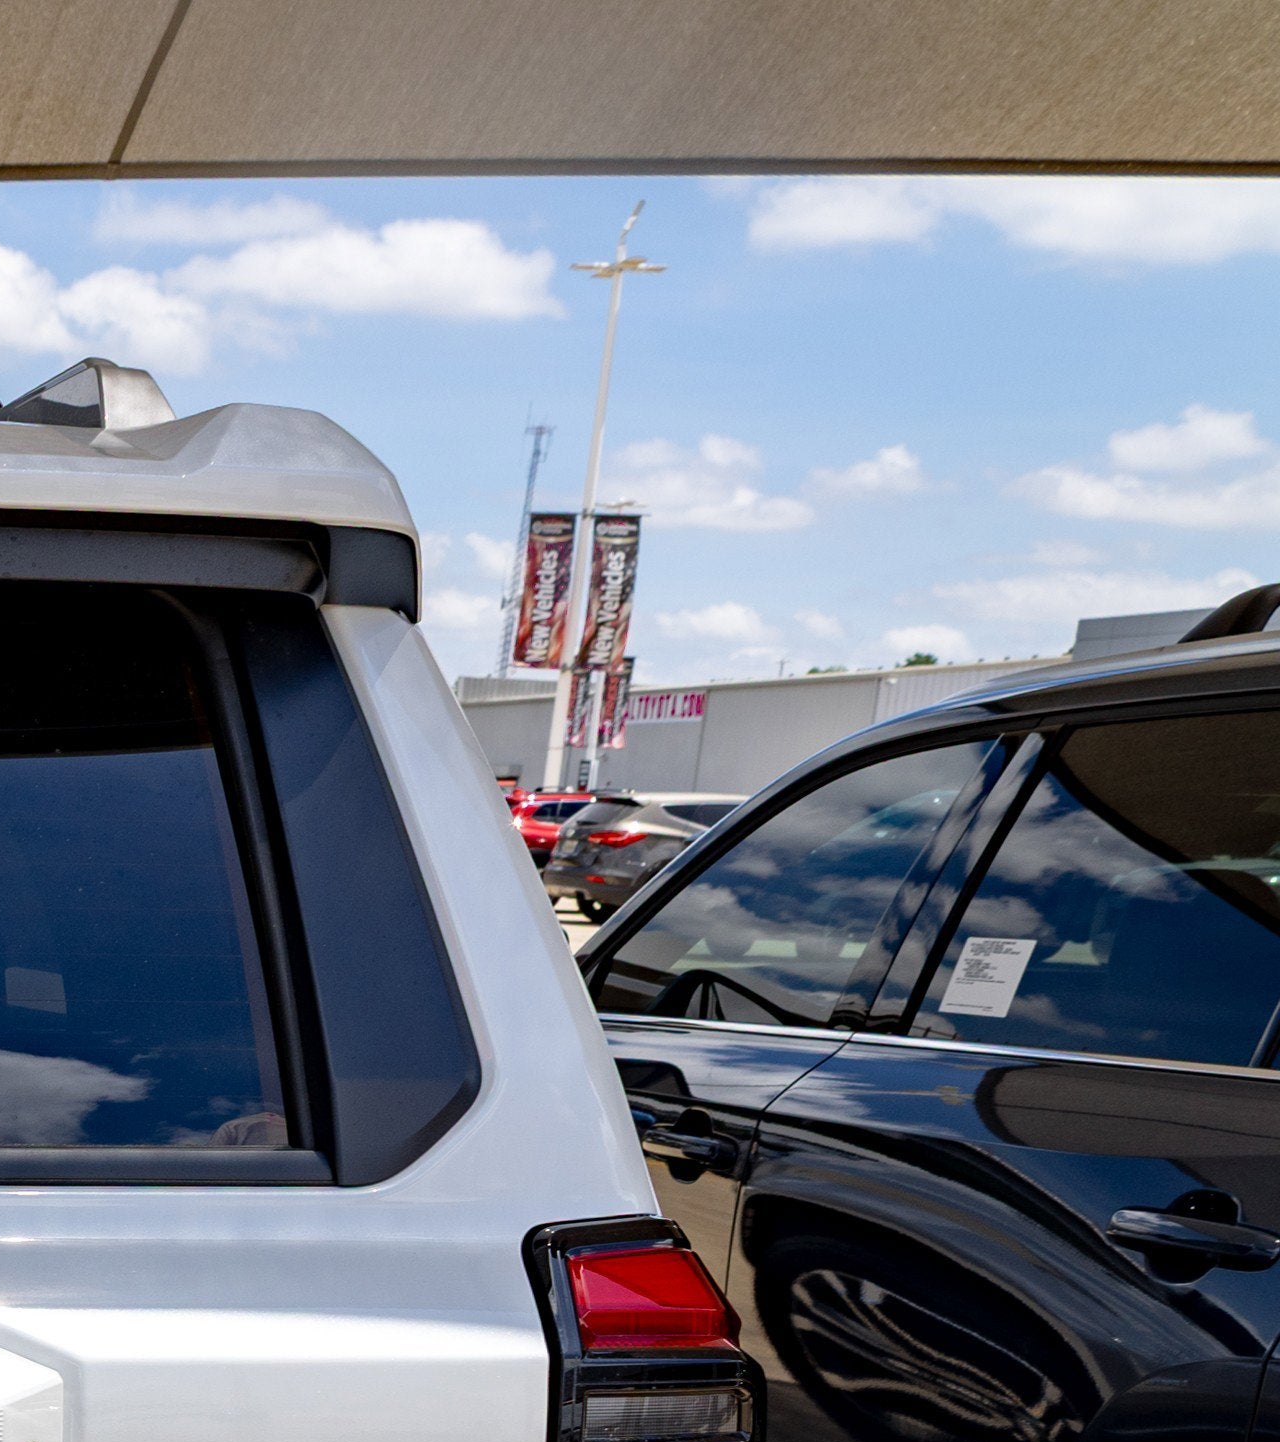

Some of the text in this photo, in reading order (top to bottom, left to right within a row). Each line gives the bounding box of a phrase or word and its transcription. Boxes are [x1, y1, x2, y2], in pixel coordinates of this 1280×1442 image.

[532, 549, 558, 621] Vehicles
[597, 550, 625, 623] Vehicles
[525, 624, 551, 663] New
[588, 626, 615, 664] New
